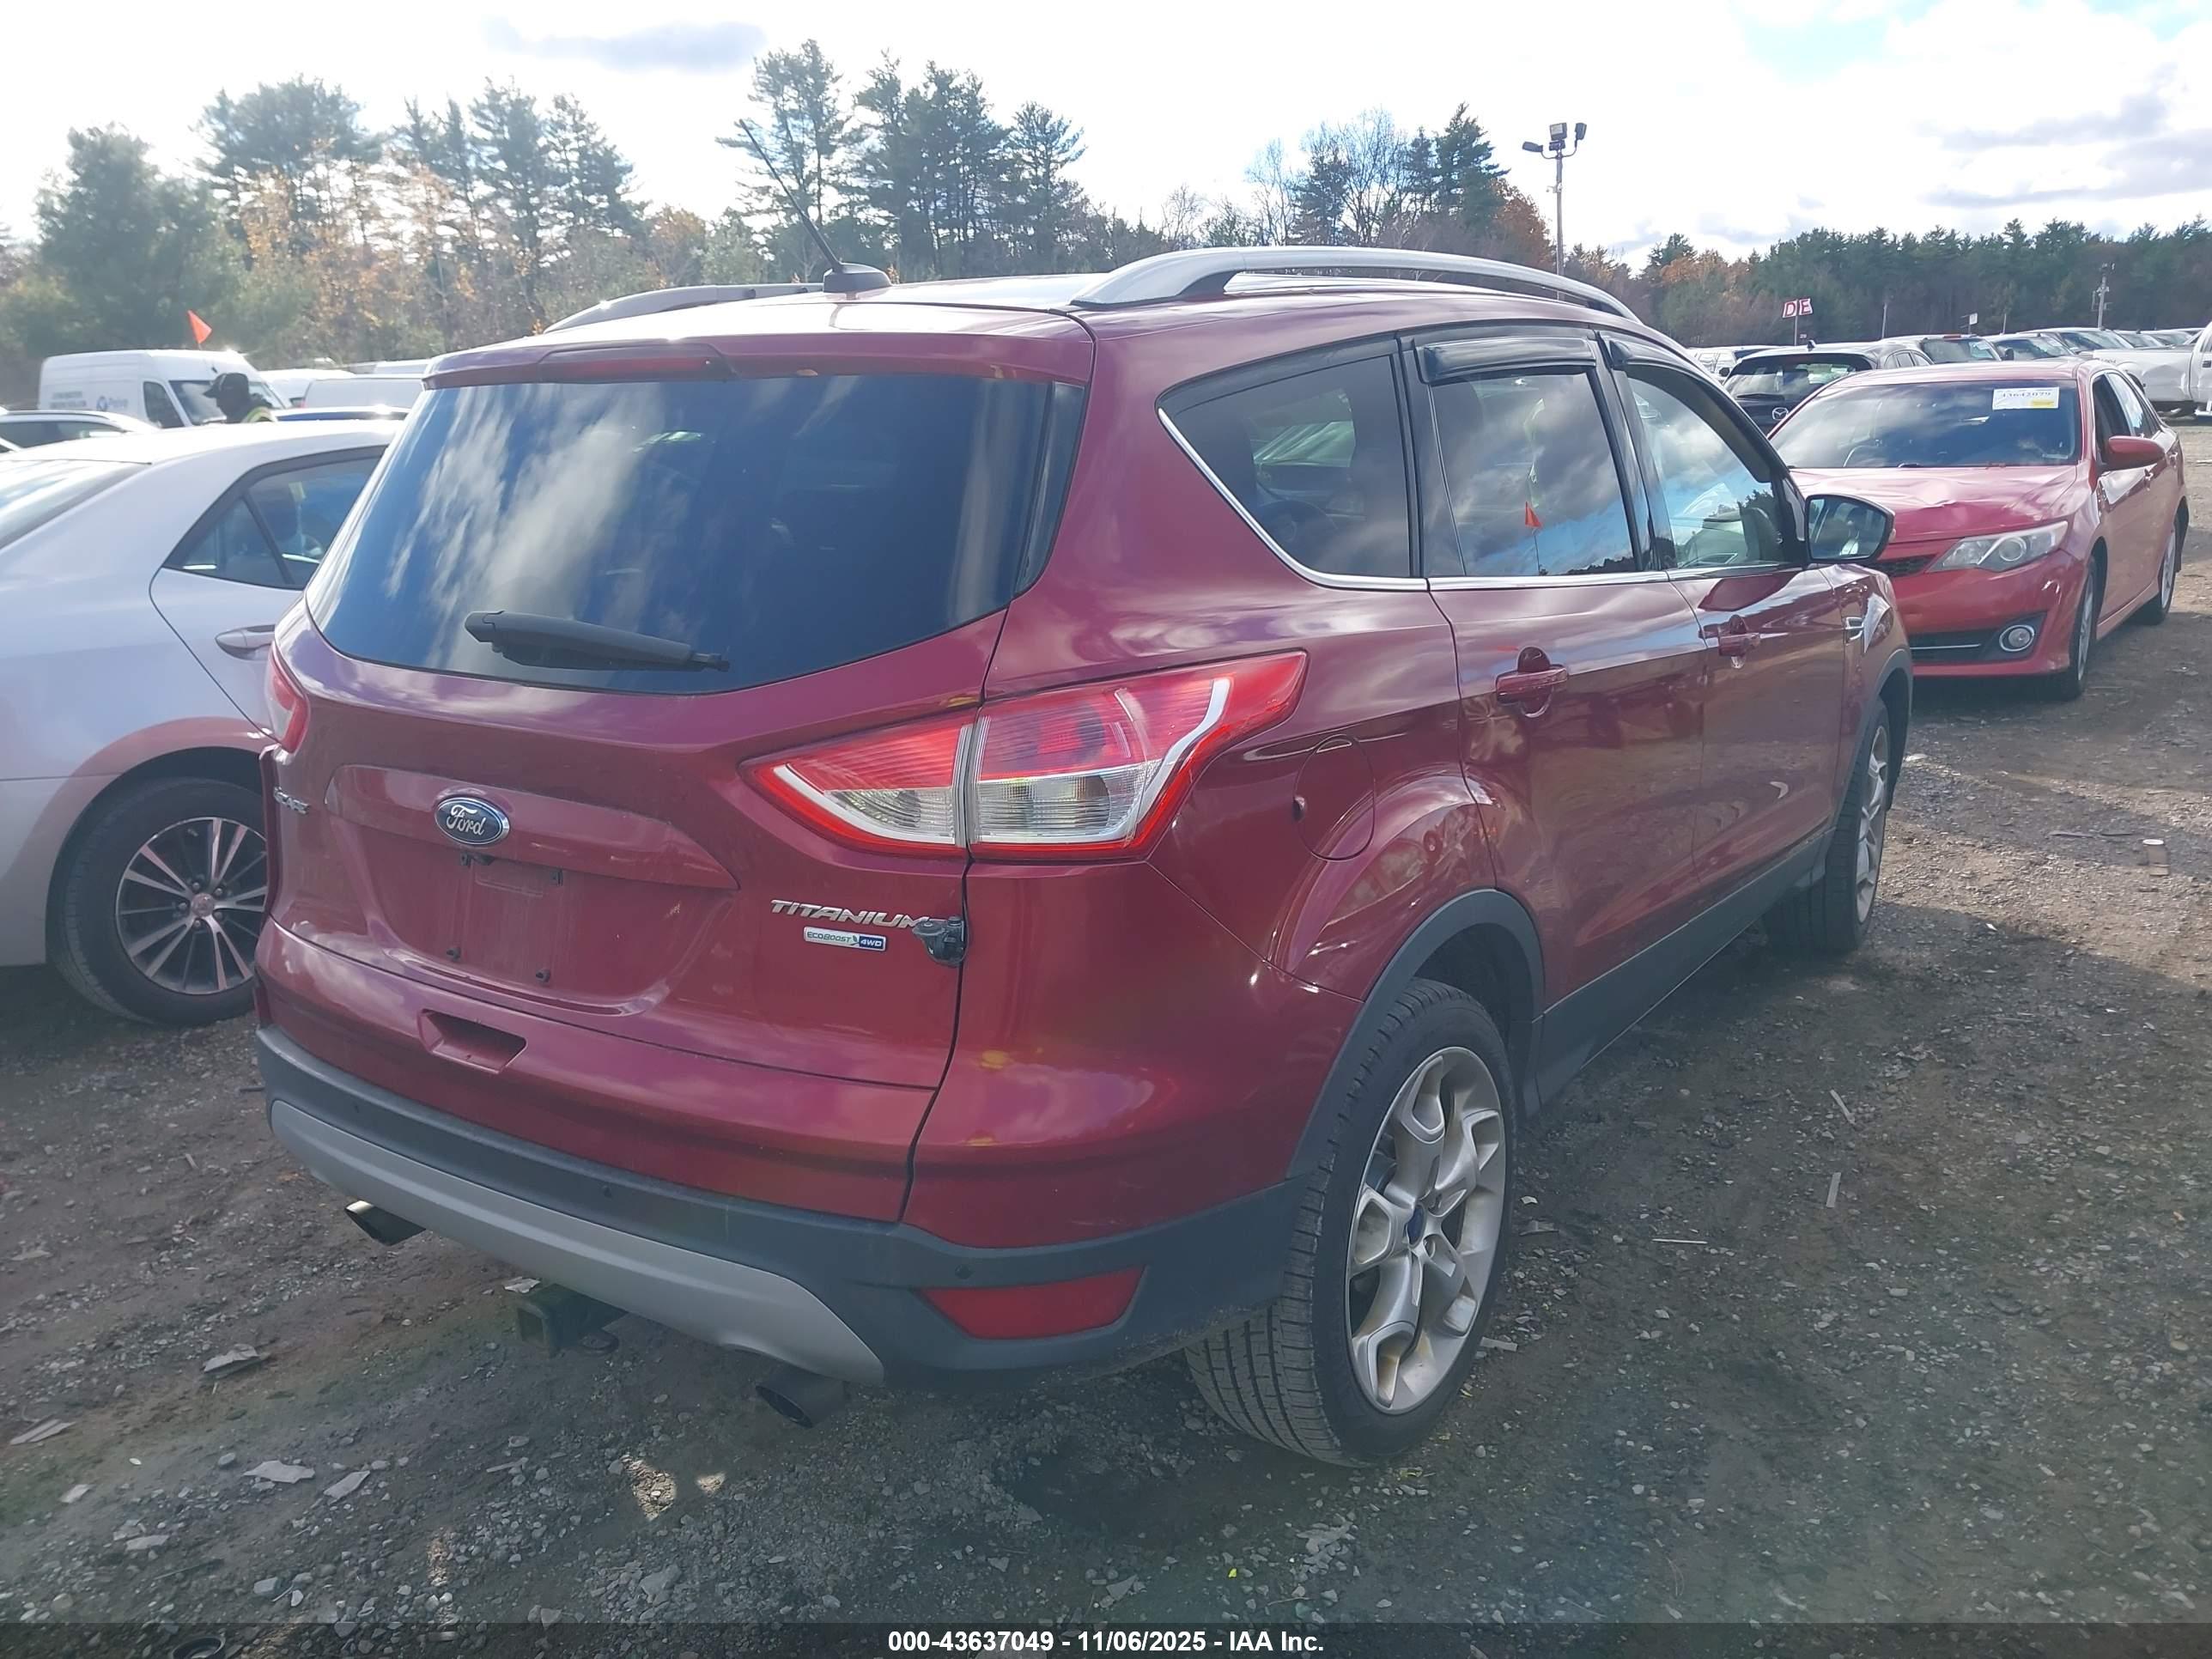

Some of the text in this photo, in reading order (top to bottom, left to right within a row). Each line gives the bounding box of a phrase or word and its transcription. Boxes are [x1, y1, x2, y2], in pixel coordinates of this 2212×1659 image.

[446, 804, 487, 836] Ford
[770, 899, 930, 929] TITANIUM
[806, 931, 883, 947] ECOBOOST 4WD
